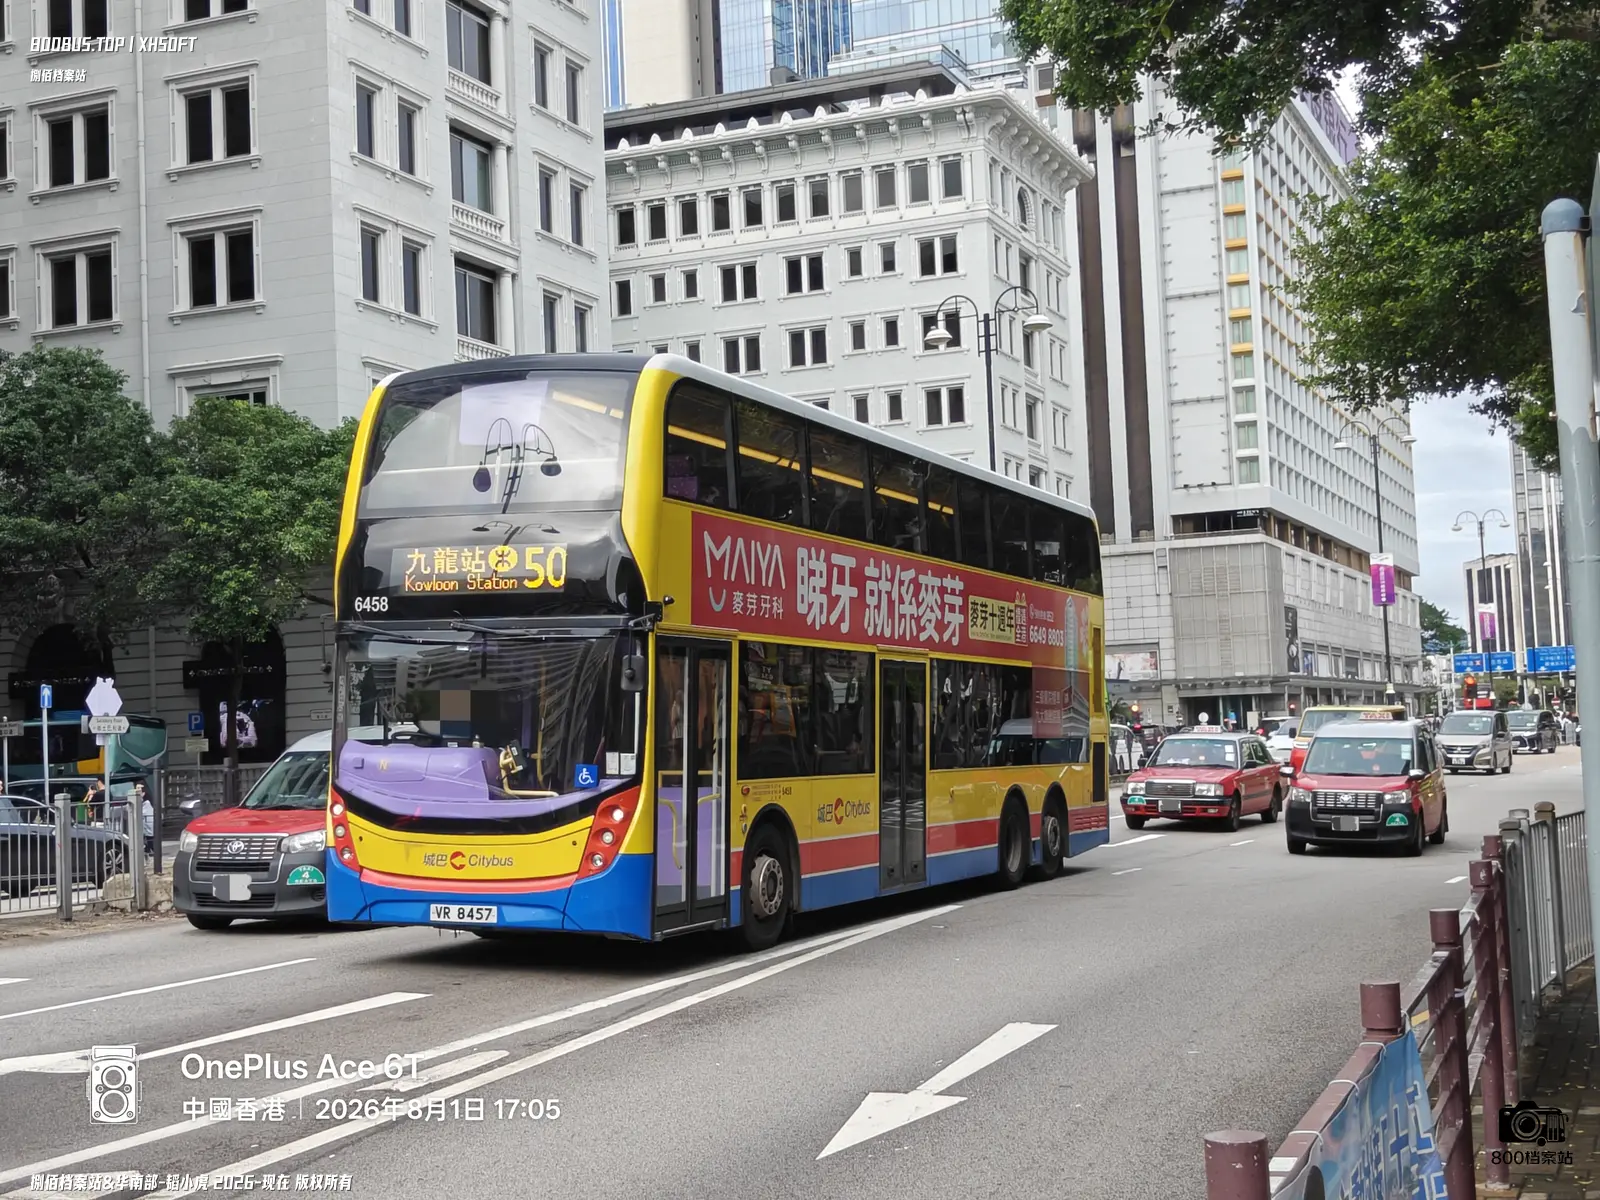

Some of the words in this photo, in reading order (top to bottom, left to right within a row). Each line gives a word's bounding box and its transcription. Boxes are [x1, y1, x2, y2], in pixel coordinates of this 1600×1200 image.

[406, 546, 486, 575] 九龍站
[523, 546, 567, 588] 50
[704, 530, 786, 589] MAIYA
[404, 573, 459, 592] Kowloon
[466, 573, 518, 590] Station
[354, 596, 389, 612] 6458
[732, 591, 784, 620] 麥芽牙科
[797, 547, 858, 634] 睇牙
[864, 556, 964, 646] 就係麥芽
[191, 714, 201, 730] P
[845, 800, 871, 818] Citybus
[423, 853, 448, 867] 城巴
[468, 853, 514, 869] Citybus
[434, 905, 451, 919] VR
[457, 905, 492, 921] 8457
